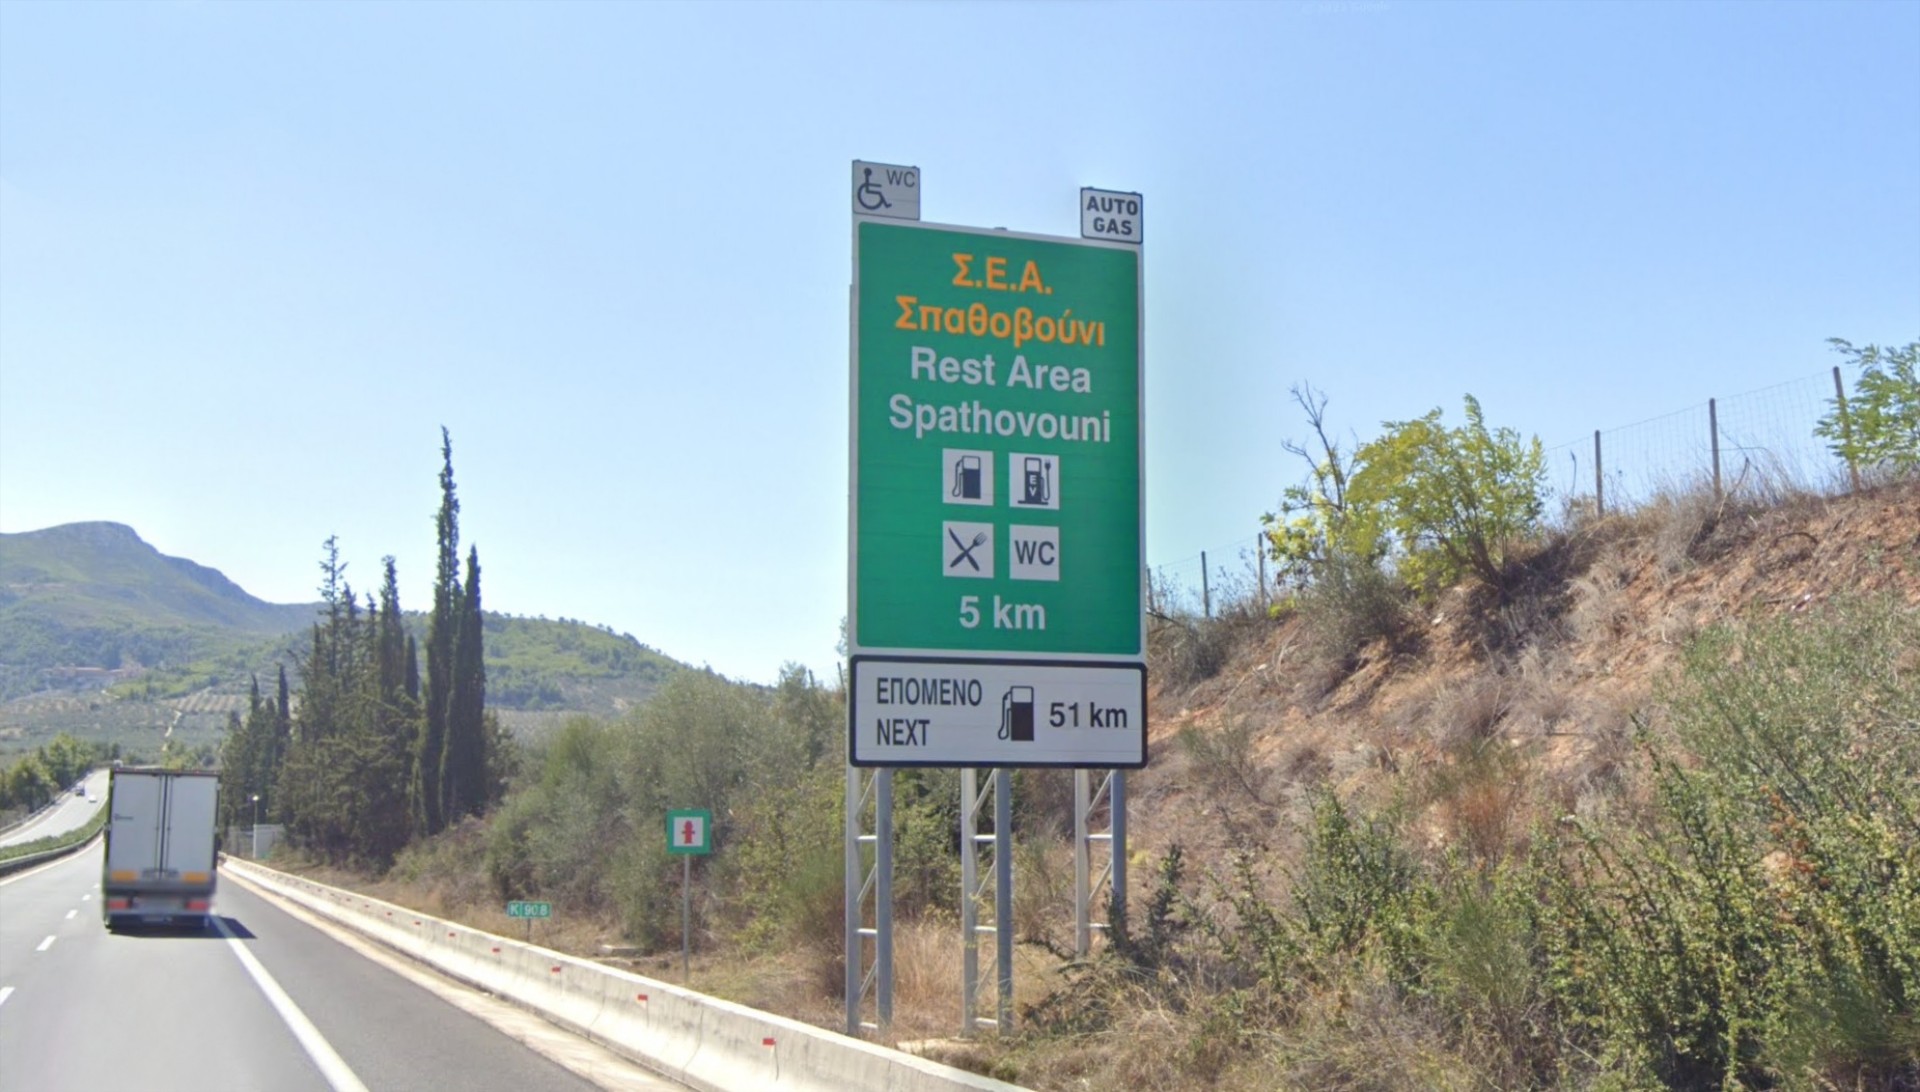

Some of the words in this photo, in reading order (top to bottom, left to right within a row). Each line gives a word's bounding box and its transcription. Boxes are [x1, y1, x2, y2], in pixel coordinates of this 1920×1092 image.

[886, 168, 917, 188] WC
[1086, 196, 1139, 216] AUTO
[1093, 217, 1133, 235] GAS
[952, 253, 1053, 294] Σ.Ε.Α.
[895, 295, 1105, 348] Σπαθοβούνι
[911, 346, 995, 386] Rest
[1007, 355, 1091, 393] Area
[889, 393, 1110, 442] Spathovouni
[1014, 540, 1055, 565] WC
[959, 596, 980, 628] 5
[993, 595, 1046, 629] km
[876, 677, 982, 706] ΕΠΟΜΕΝΟ
[1049, 702, 1079, 728] 51
[1089, 702, 1128, 728] km
[876, 719, 930, 746] NEXT
